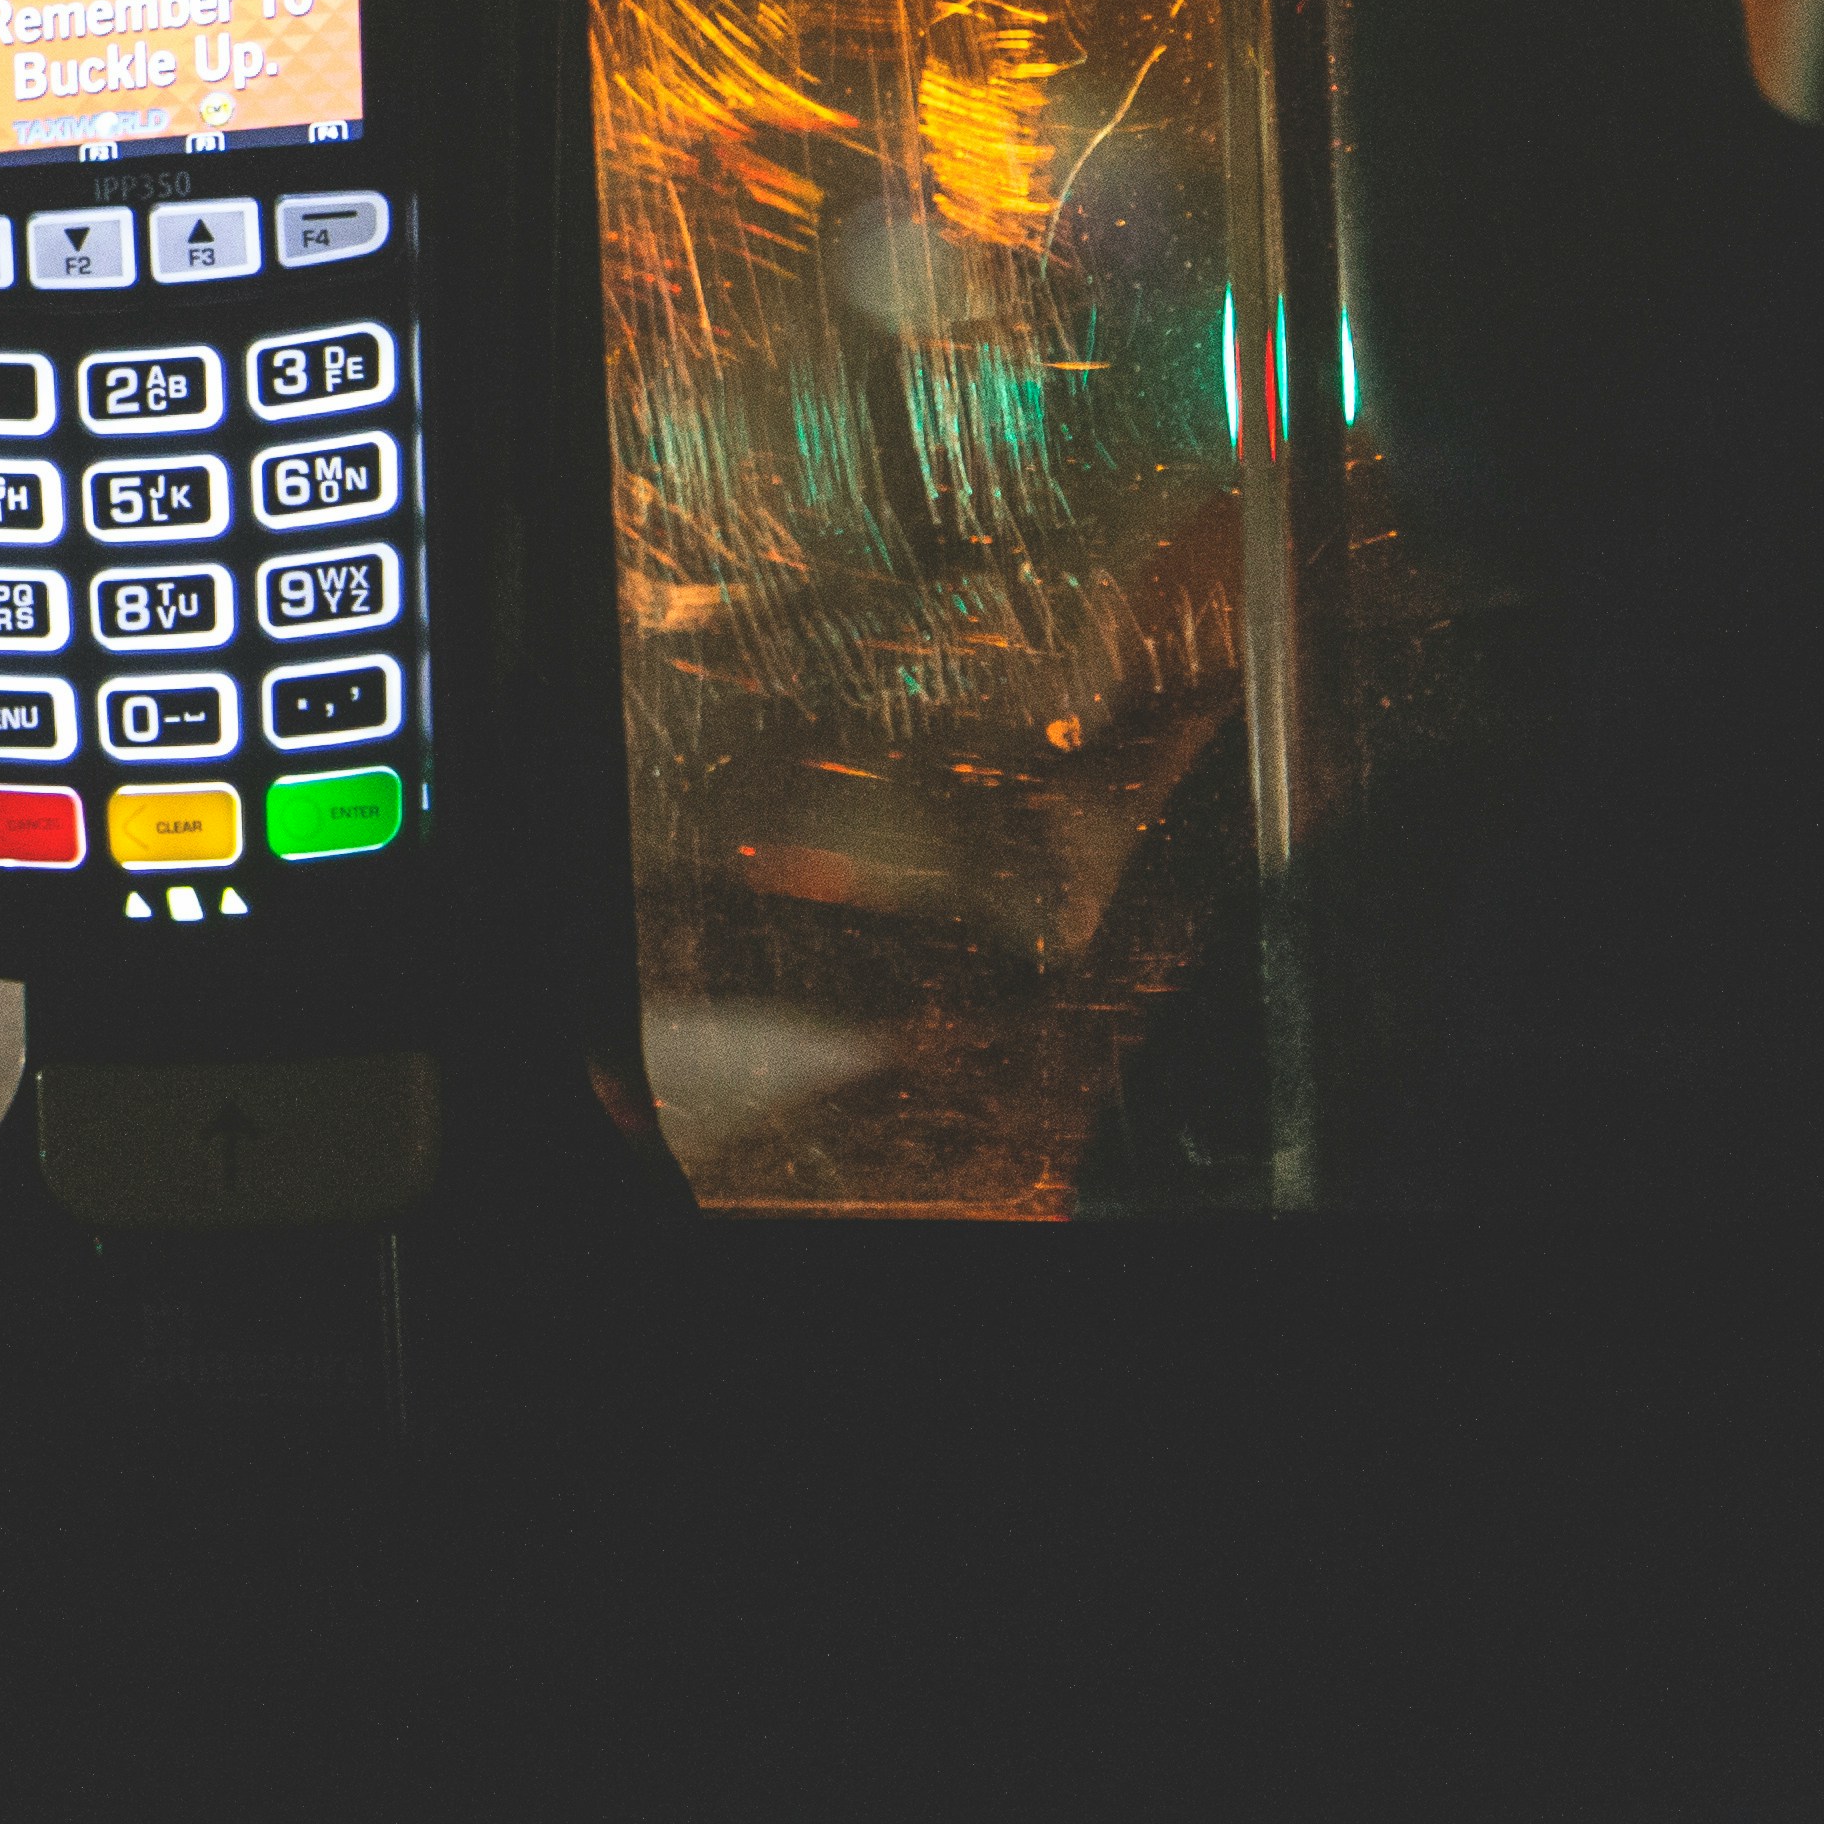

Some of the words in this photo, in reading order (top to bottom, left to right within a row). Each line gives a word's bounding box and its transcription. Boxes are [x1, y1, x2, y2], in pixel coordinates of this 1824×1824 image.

[12, 37, 178, 102] Buckle
[194, 33, 280, 90] Up.
[301, 228, 332, 250] F4
[64, 254, 93, 277] F2
[187, 246, 216, 268] F3
[330, 805, 380, 820] ENTER
[155, 817, 203, 836] CLEAR
